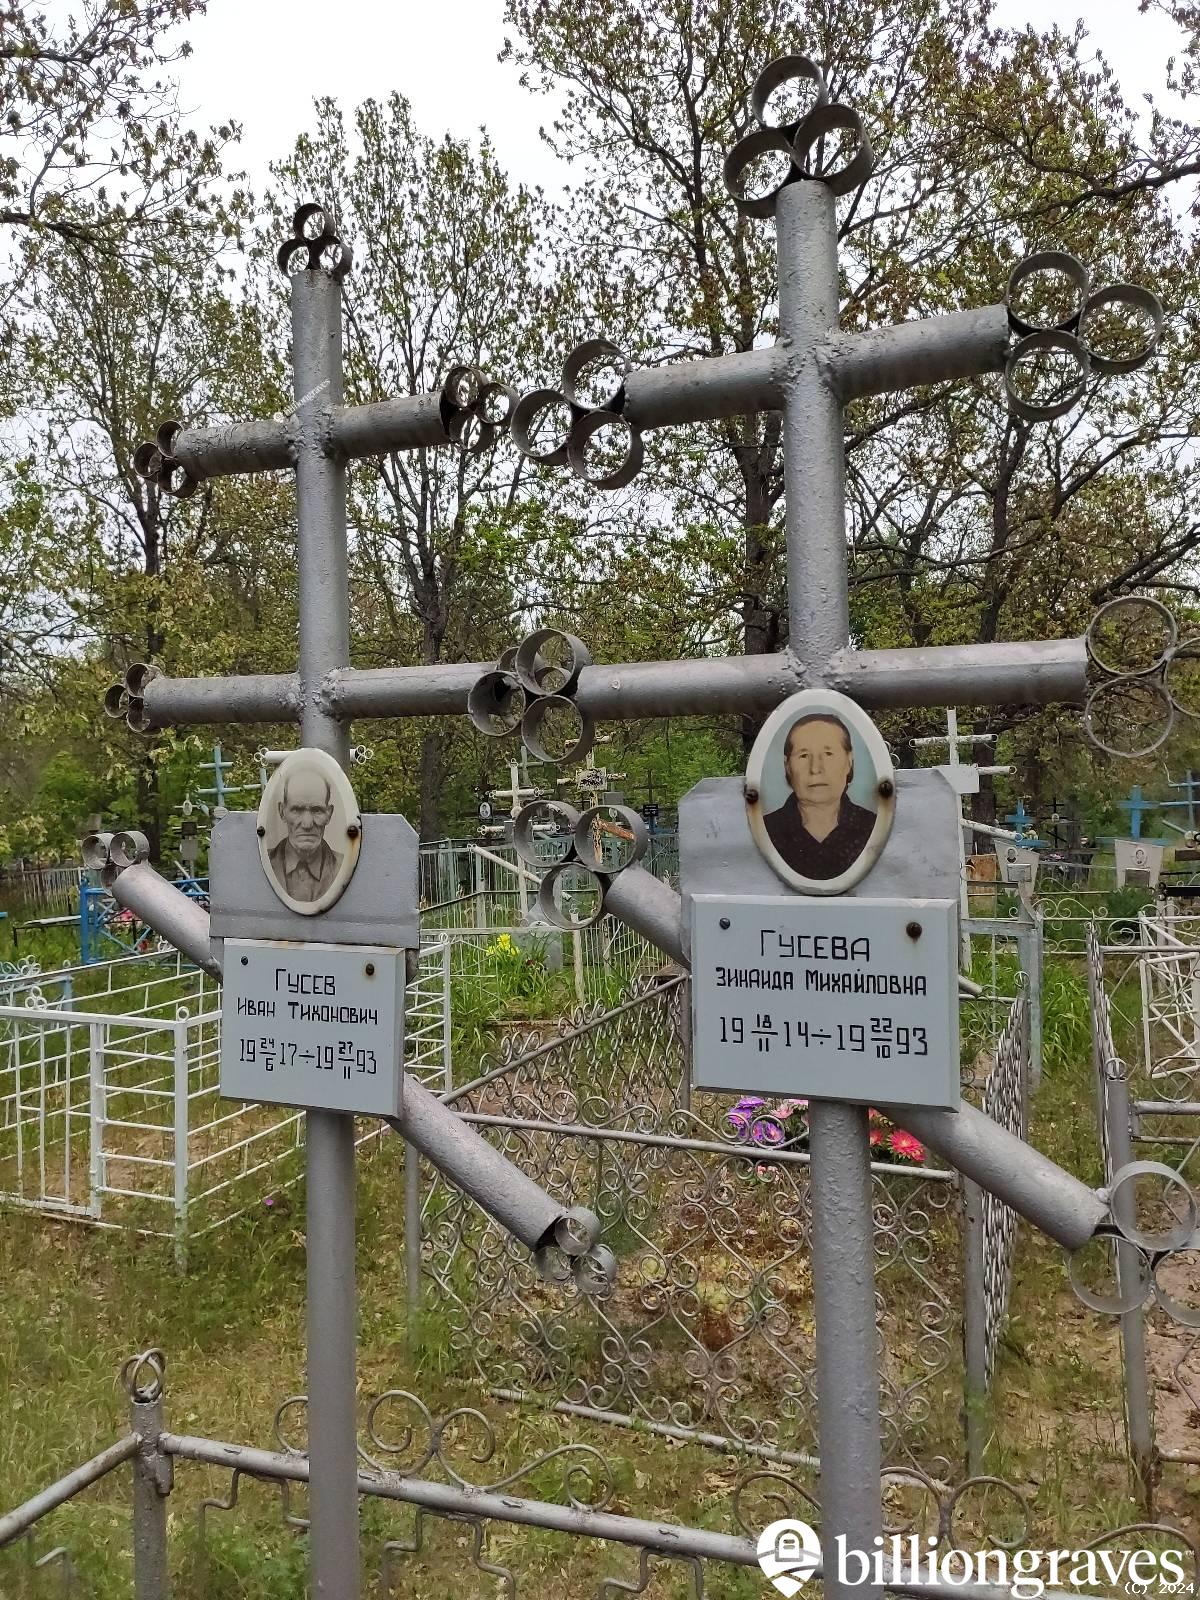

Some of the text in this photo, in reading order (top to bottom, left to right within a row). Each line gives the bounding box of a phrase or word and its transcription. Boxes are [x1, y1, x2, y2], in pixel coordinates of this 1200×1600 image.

[761, 930, 870, 962] ГУСЕВА
[275, 968, 336, 995] ГУСЕВ
[716, 967, 927, 996] ЗИНАИДА МИХАЙЛОВНА
[237, 998, 378, 1025] ИВАН ТИХОНОВИЧ
